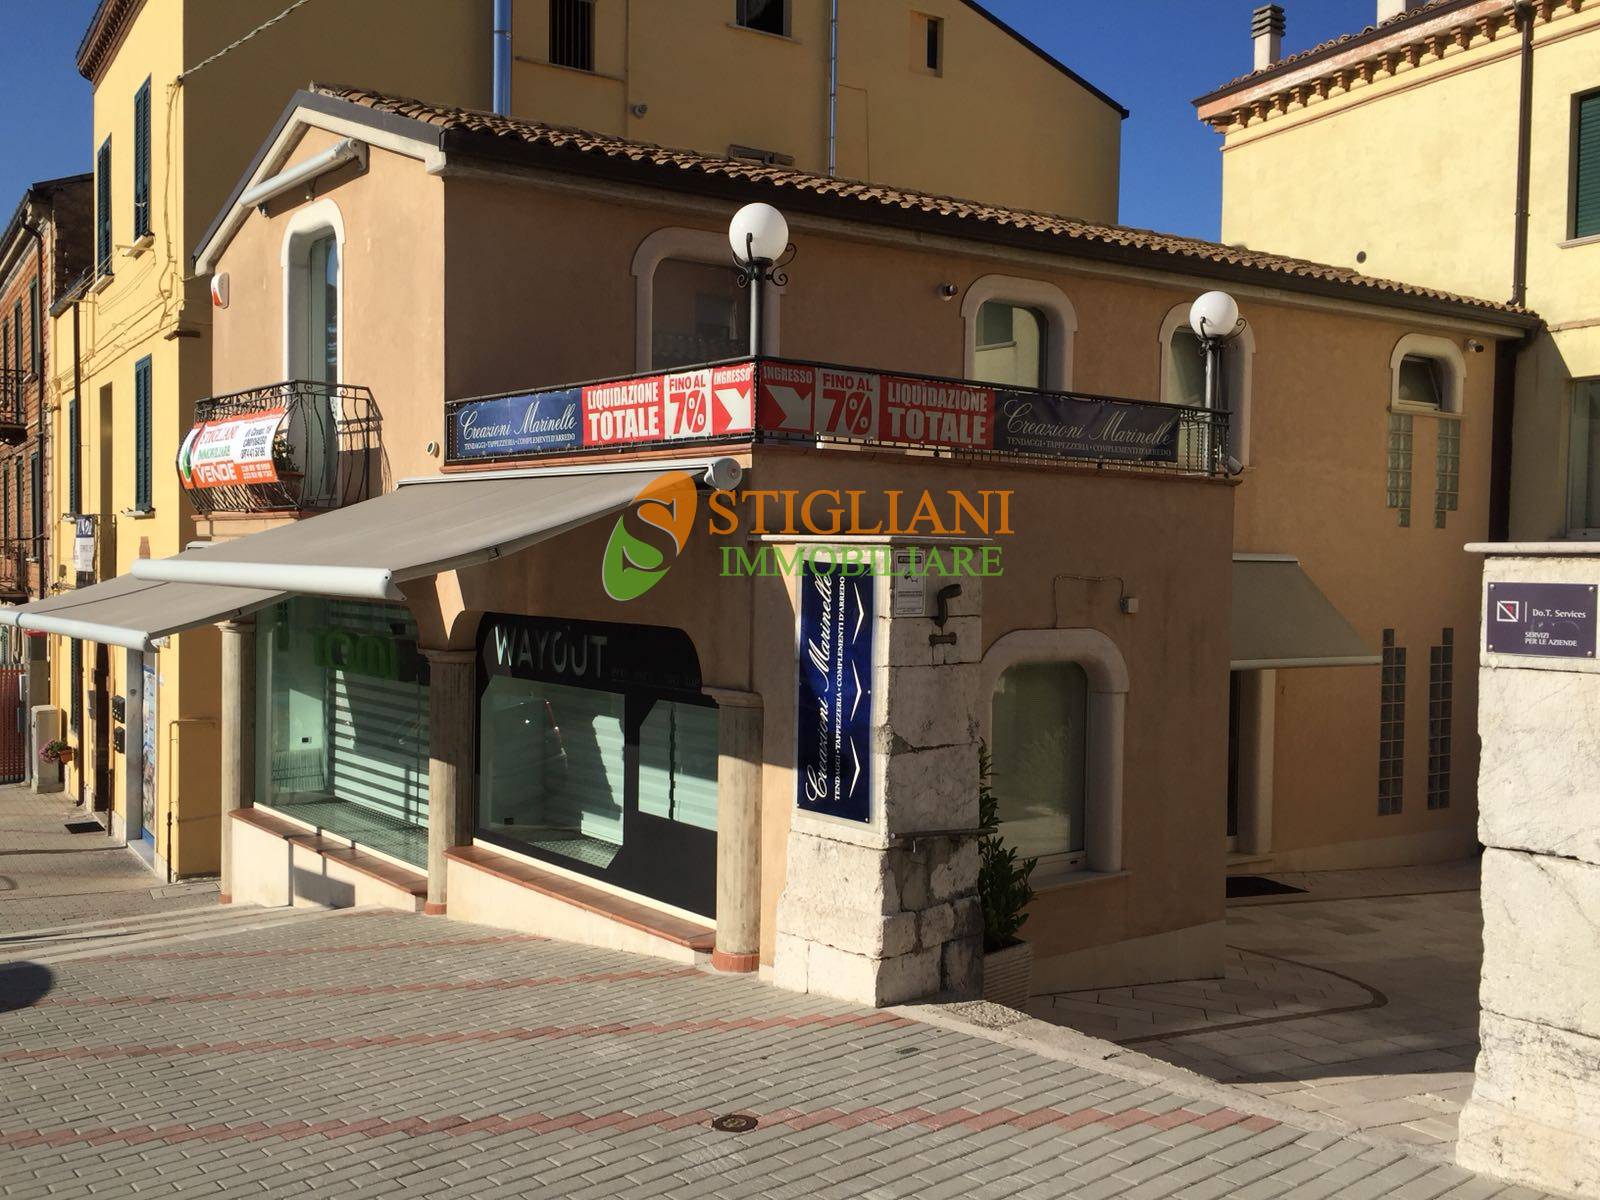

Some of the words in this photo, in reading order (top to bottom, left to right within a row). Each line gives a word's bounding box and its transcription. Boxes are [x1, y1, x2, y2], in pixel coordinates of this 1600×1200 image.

[669, 376, 692, 391] FINO
[694, 374, 706, 389] AL
[714, 367, 751, 385] INGRESSO
[763, 365, 813, 383] INGRESSO
[823, 373, 855, 390] FINO
[857, 376, 873, 392] AL
[587, 381, 659, 410] LIQUIDAZIONE
[887, 381, 988, 412] LIQUIDAZIONE
[460, 410, 512, 440] Creazioni
[514, 400, 577, 435] Marinelle
[588, 405, 660, 441] TOTALE
[887, 406, 987, 446] TOTALE
[1003, 399, 1086, 439] Creazioni
[1088, 409, 1175, 446] Marinelle
[1007, 436, 1043, 447] TENDAGGI
[196, 463, 237, 483] VENDE
[838, 576, 846, 621] D'ARREDO
[1532, 608, 1552, 617] Do.T.
[1554, 609, 1587, 618] Services
[808, 572, 832, 693] Marinelle
[1524, 631, 1550, 639] SERVIZI
[1548, 639, 1577, 647] AZIENDE
[836, 623, 844, 687] COMPLEMENTI
[805, 696, 829, 801] Creazioni
